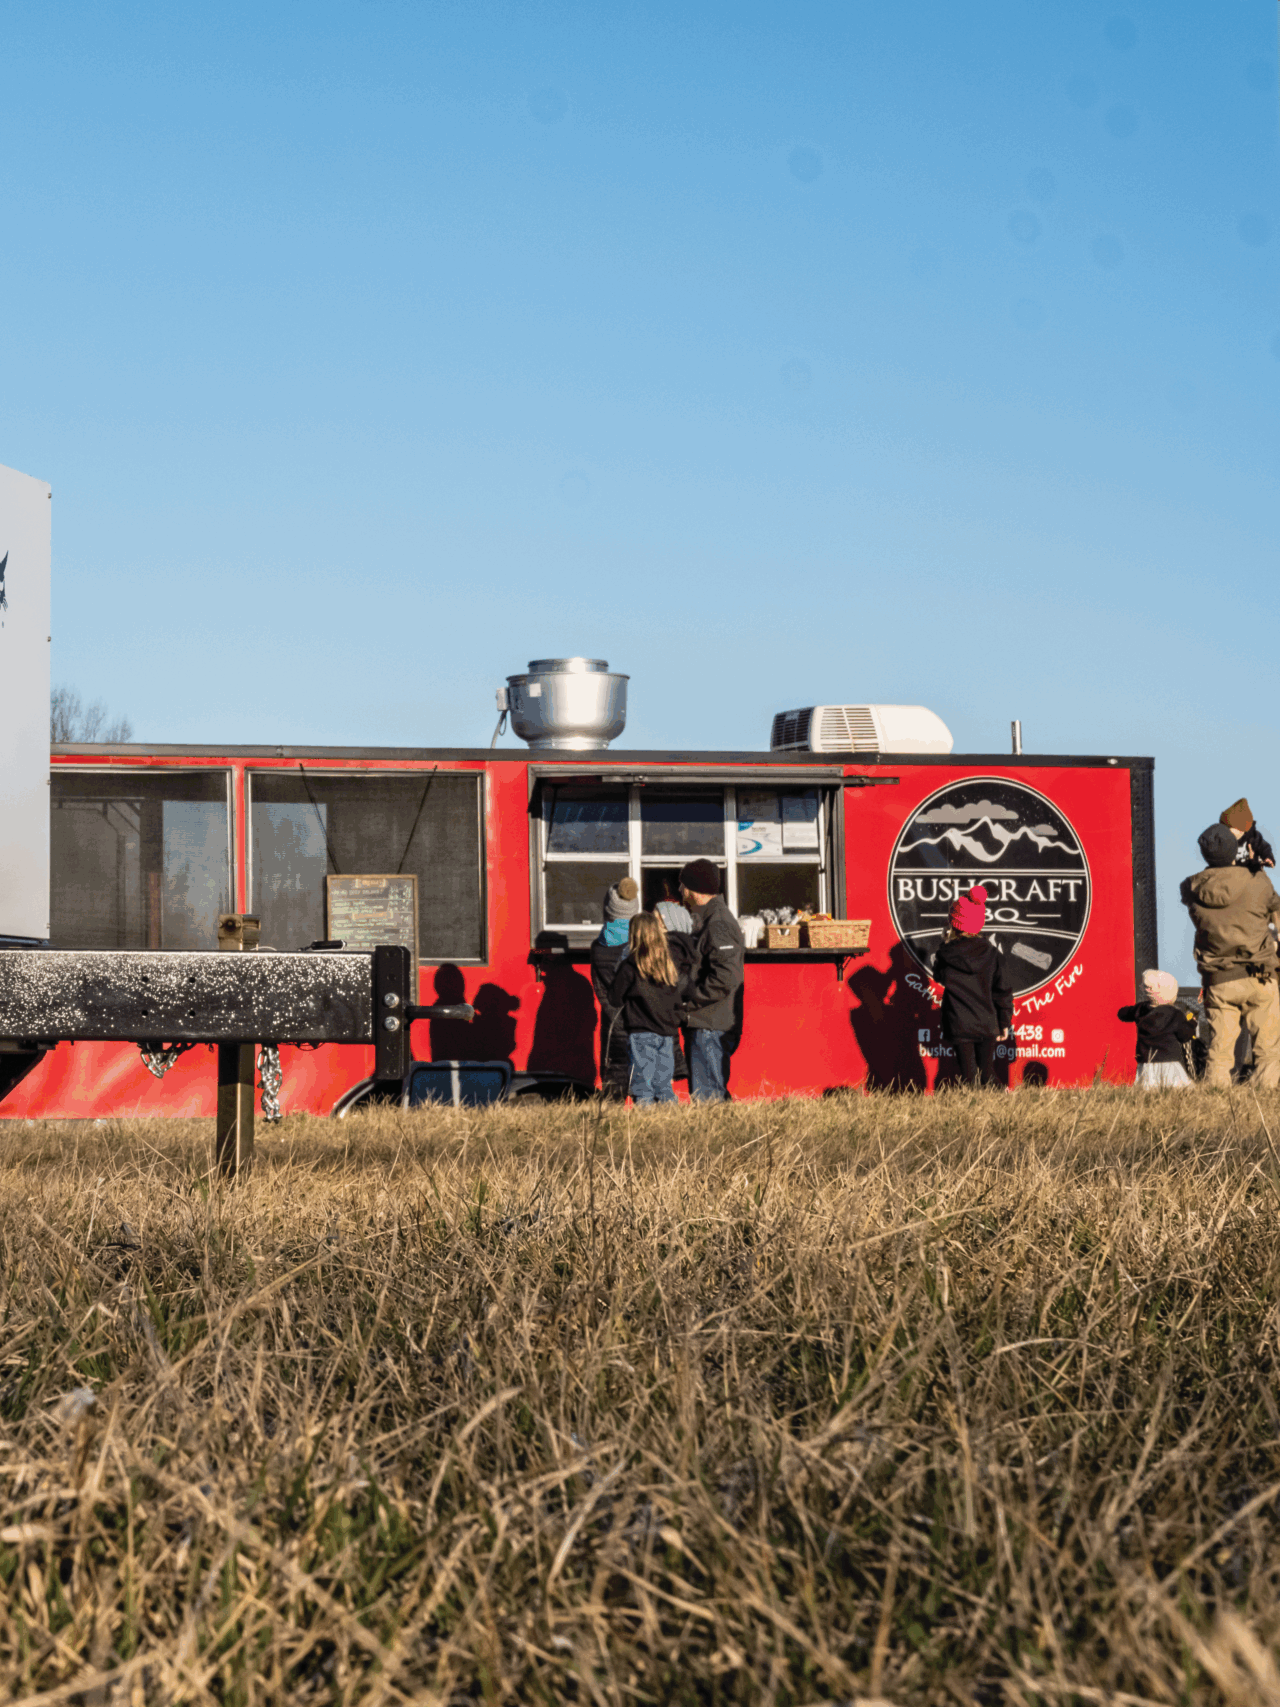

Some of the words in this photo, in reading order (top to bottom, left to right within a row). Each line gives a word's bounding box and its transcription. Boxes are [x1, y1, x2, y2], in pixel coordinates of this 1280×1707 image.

[897, 878, 1083, 902] BUSHCRAFT
[985, 907, 1038, 925] BQ
[1021, 991, 1055, 1014] The
[1054, 963, 1083, 996] Fire
